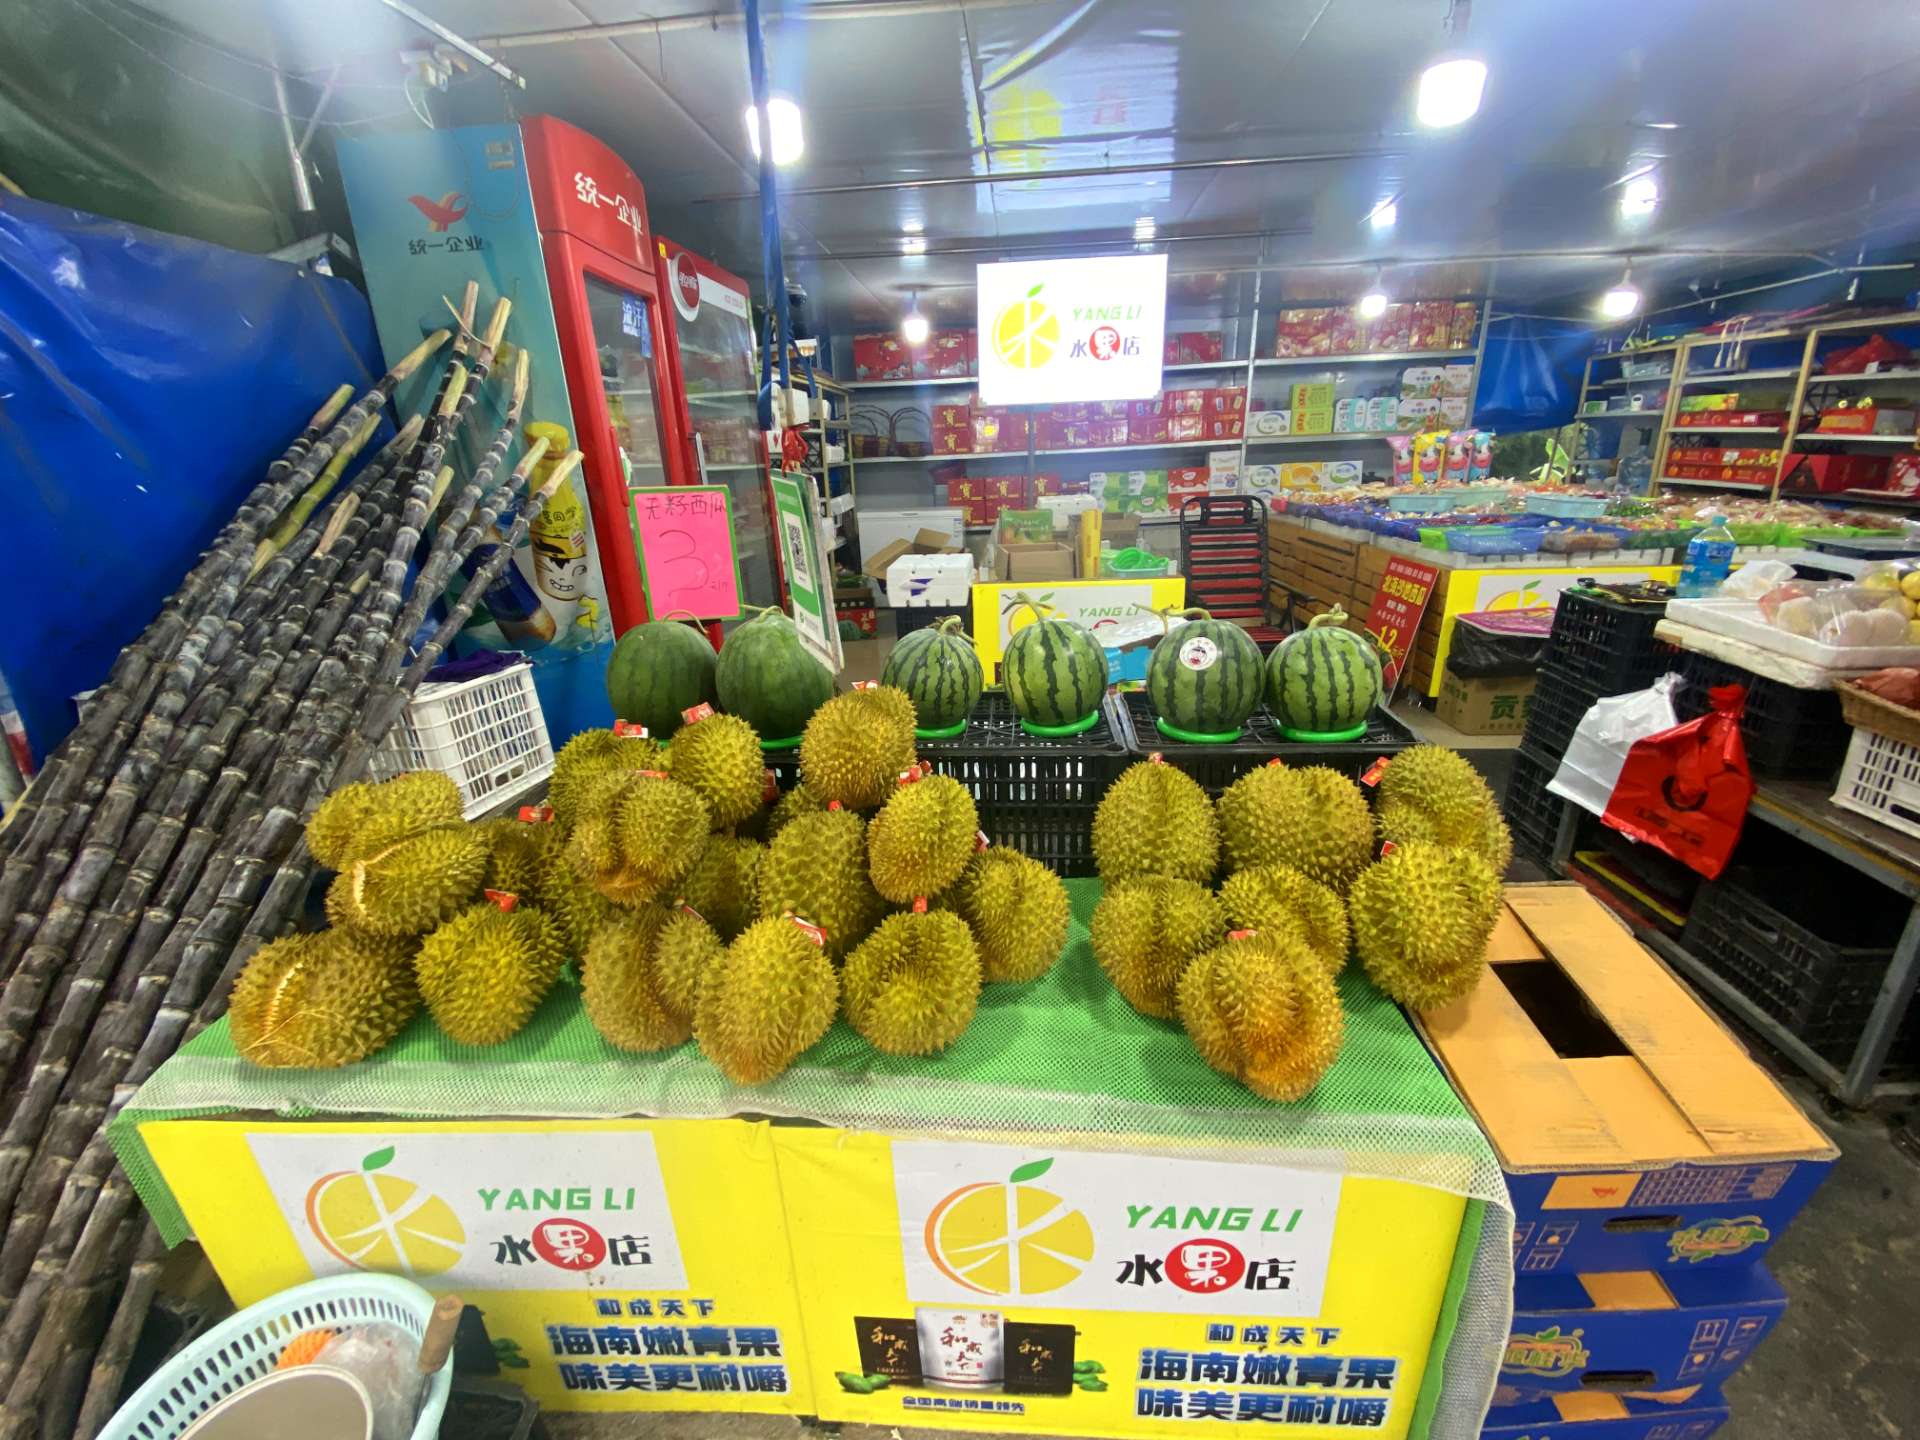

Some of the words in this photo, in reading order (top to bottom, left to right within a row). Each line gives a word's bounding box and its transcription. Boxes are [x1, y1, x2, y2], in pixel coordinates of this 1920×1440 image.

[574, 171, 643, 236] 统一企业
[408, 235, 484, 256] 统一企业
[1072, 306, 1122, 321] YANG
[1126, 305, 1143, 320] LI
[1070, 327, 1140, 361] 水果店
[659, 529, 709, 597] 3
[1078, 607, 1123, 617] YANG
[1126, 607, 1140, 617] LI
[477, 1188, 591, 1210] YANG
[604, 1187, 636, 1210] LI
[1127, 1205, 1253, 1232] YANG
[1260, 1208, 1303, 1232] LI
[490, 1222, 653, 1267] 水果店
[1116, 1243, 1296, 1291] 水果店
[596, 1298, 715, 1317] 和成天下
[547, 1325, 782, 1358] 海南嫩青果
[1207, 1323, 1341, 1345] 和成天下
[558, 1363, 788, 1394] 味美更耐嚼
[1140, 1349, 1397, 1390] 海南嫩青果
[1137, 1387, 1389, 1427] 味美更耐嚼
